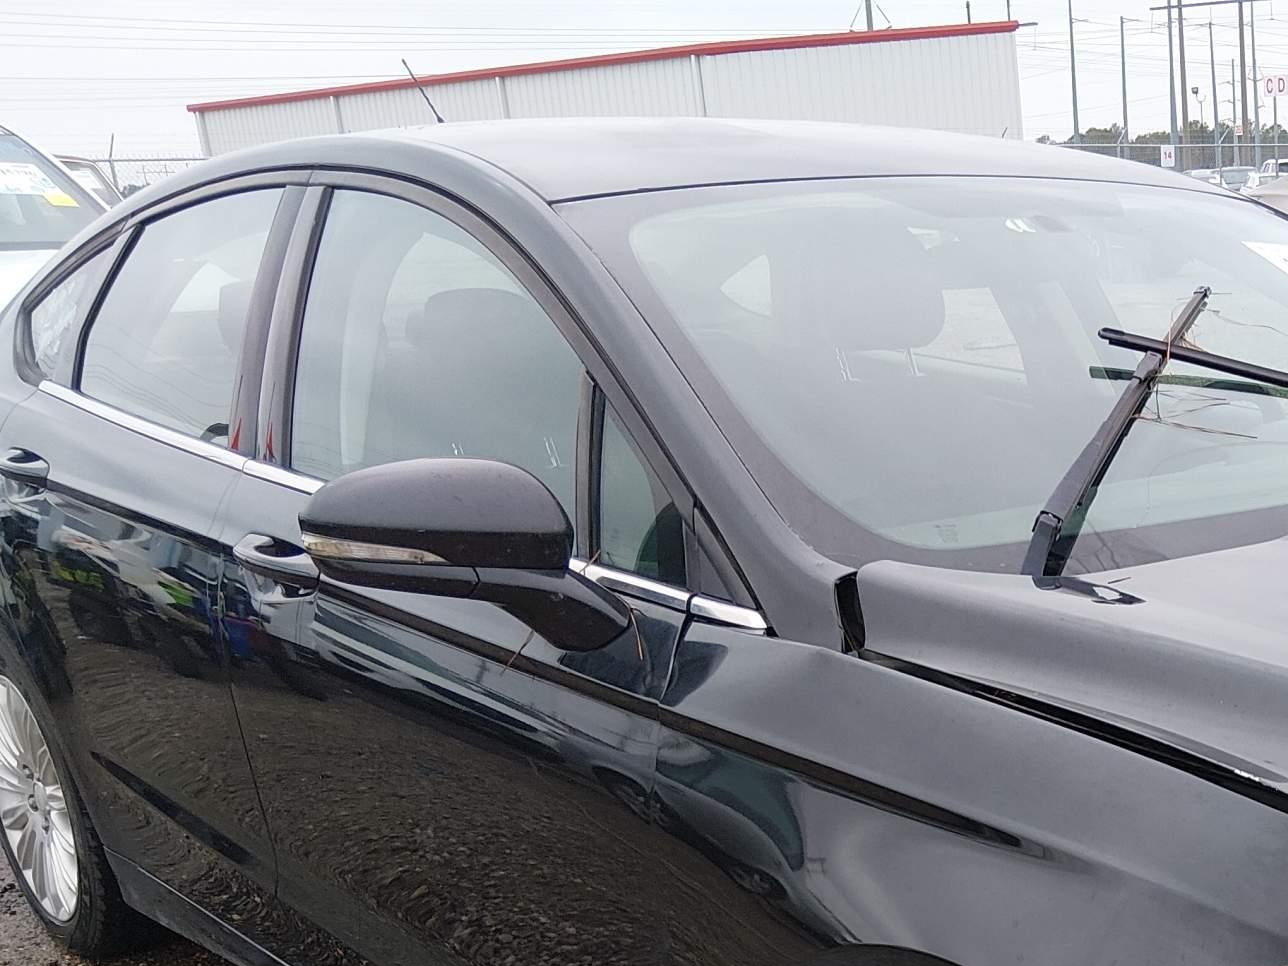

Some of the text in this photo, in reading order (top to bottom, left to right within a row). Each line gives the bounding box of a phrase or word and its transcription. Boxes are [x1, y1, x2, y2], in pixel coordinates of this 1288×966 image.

[1266, 77, 1286, 93] C D
[1163, 151, 1173, 159] 14
